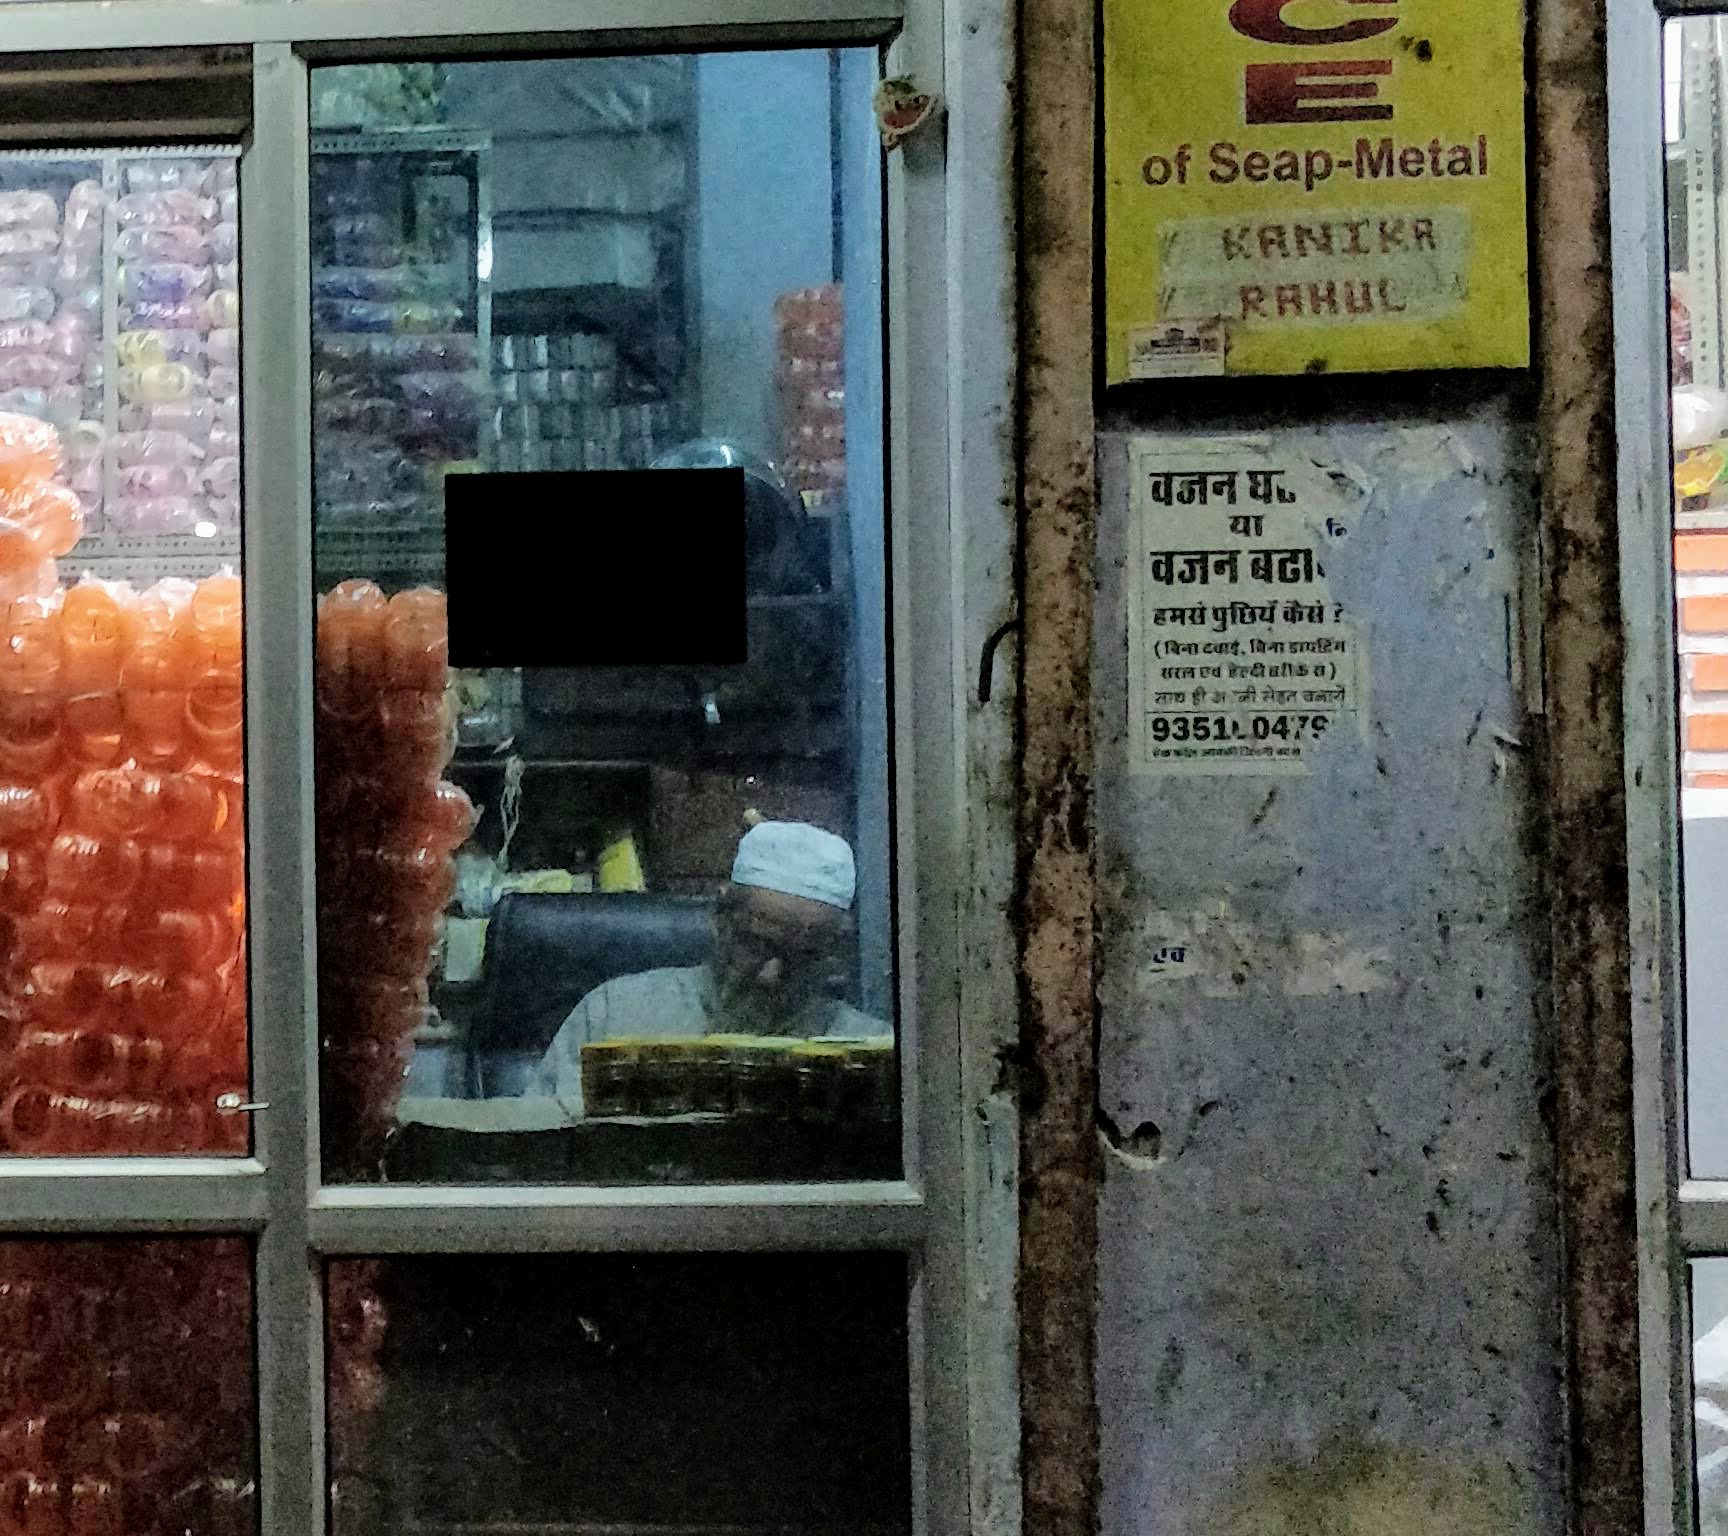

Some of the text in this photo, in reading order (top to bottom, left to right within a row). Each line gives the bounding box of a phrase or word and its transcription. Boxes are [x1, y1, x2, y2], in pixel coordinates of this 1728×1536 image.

[1141, 134, 1488, 192] of Seap-Metal
[1221, 217, 1436, 262] KANIKA
[1239, 278, 1407, 320] RAHUL
[1149, 470, 1238, 506] वजन
[1228, 515, 1264, 537] या
[1149, 550, 1241, 586] वजन
